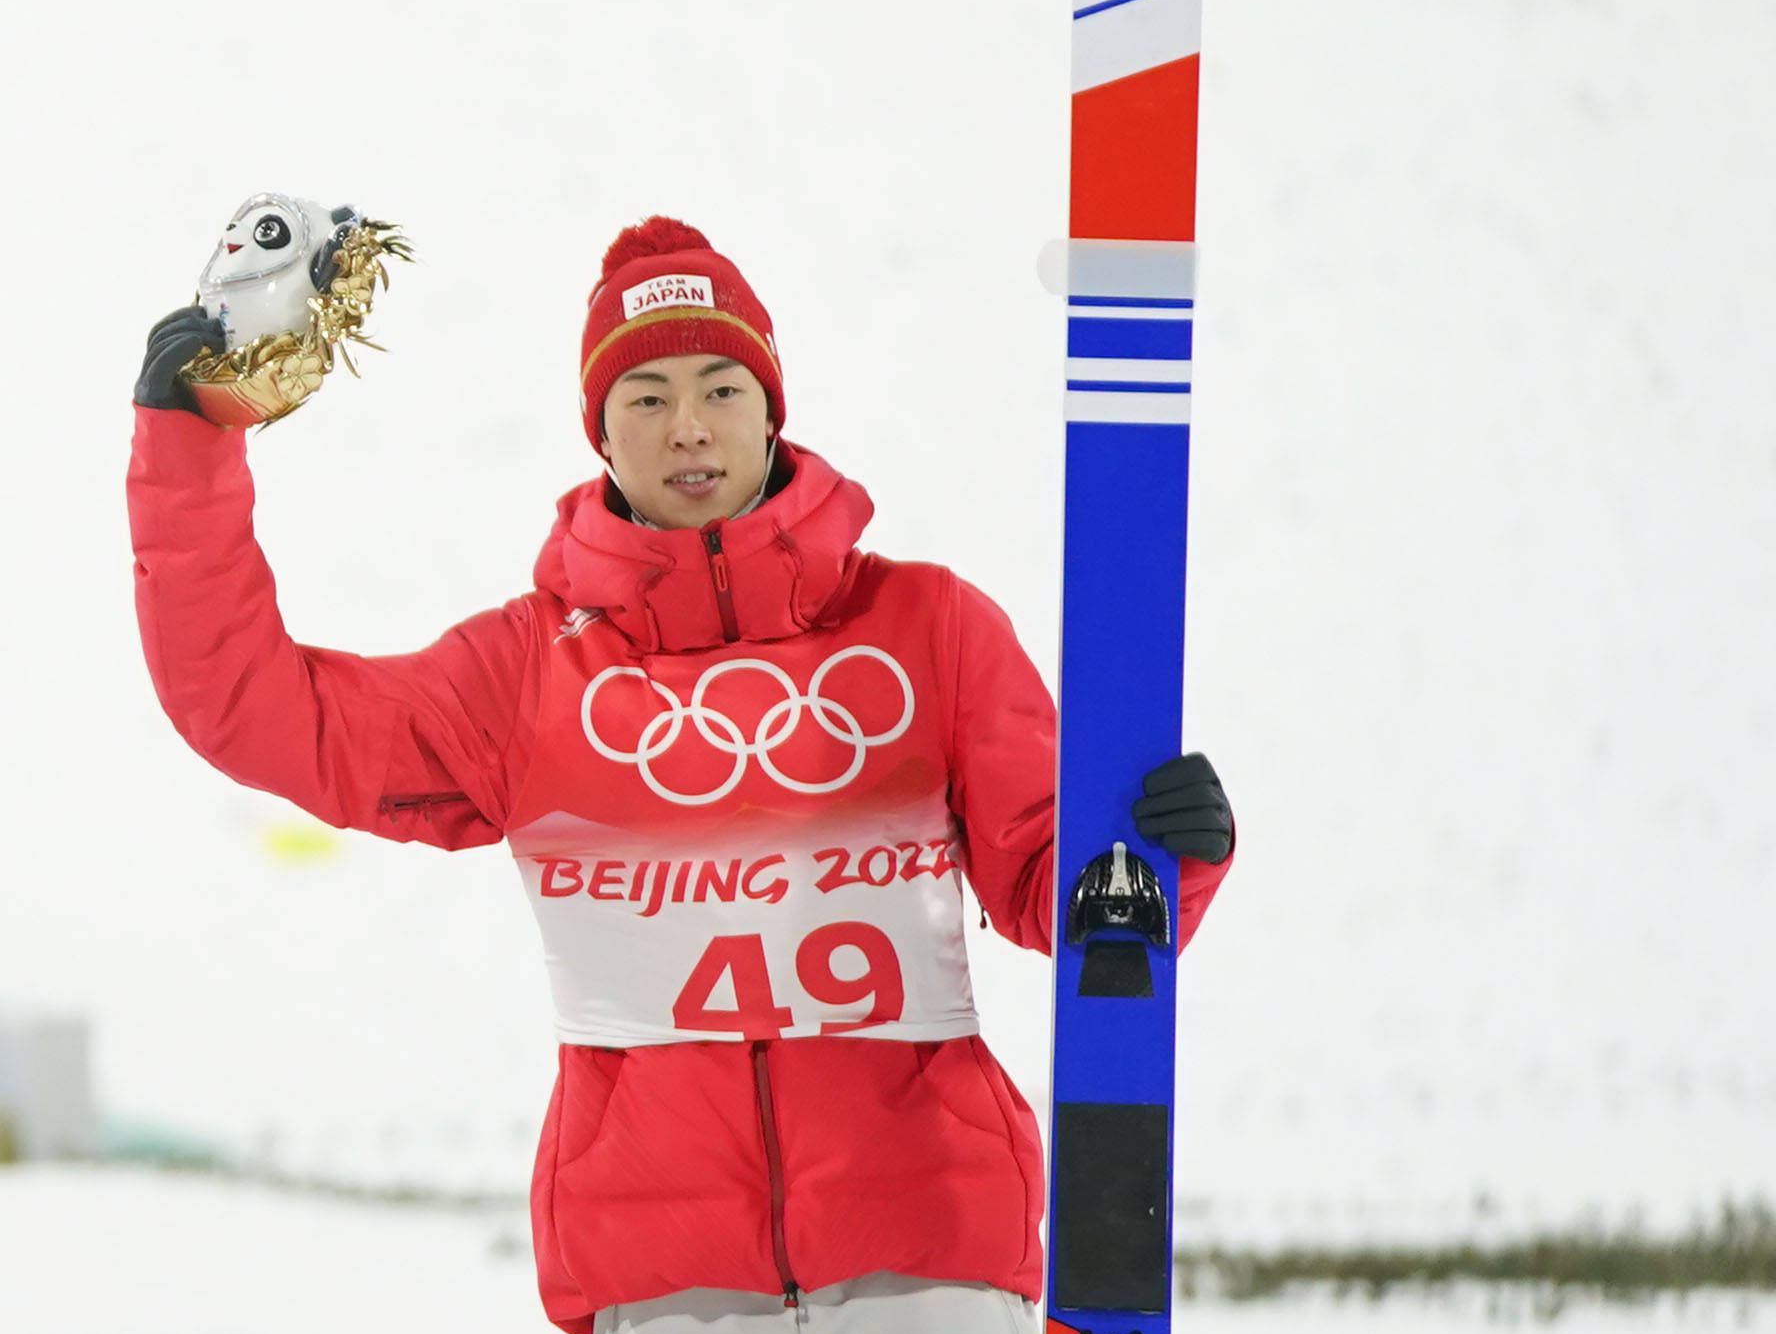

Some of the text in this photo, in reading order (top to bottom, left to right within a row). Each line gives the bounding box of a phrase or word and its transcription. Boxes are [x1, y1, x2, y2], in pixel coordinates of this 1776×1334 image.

[632, 287, 705, 311] JAPAN
[648, 277, 687, 290] TEAM
[530, 853, 790, 918] BEIJING
[671, 919, 905, 1041] 49
